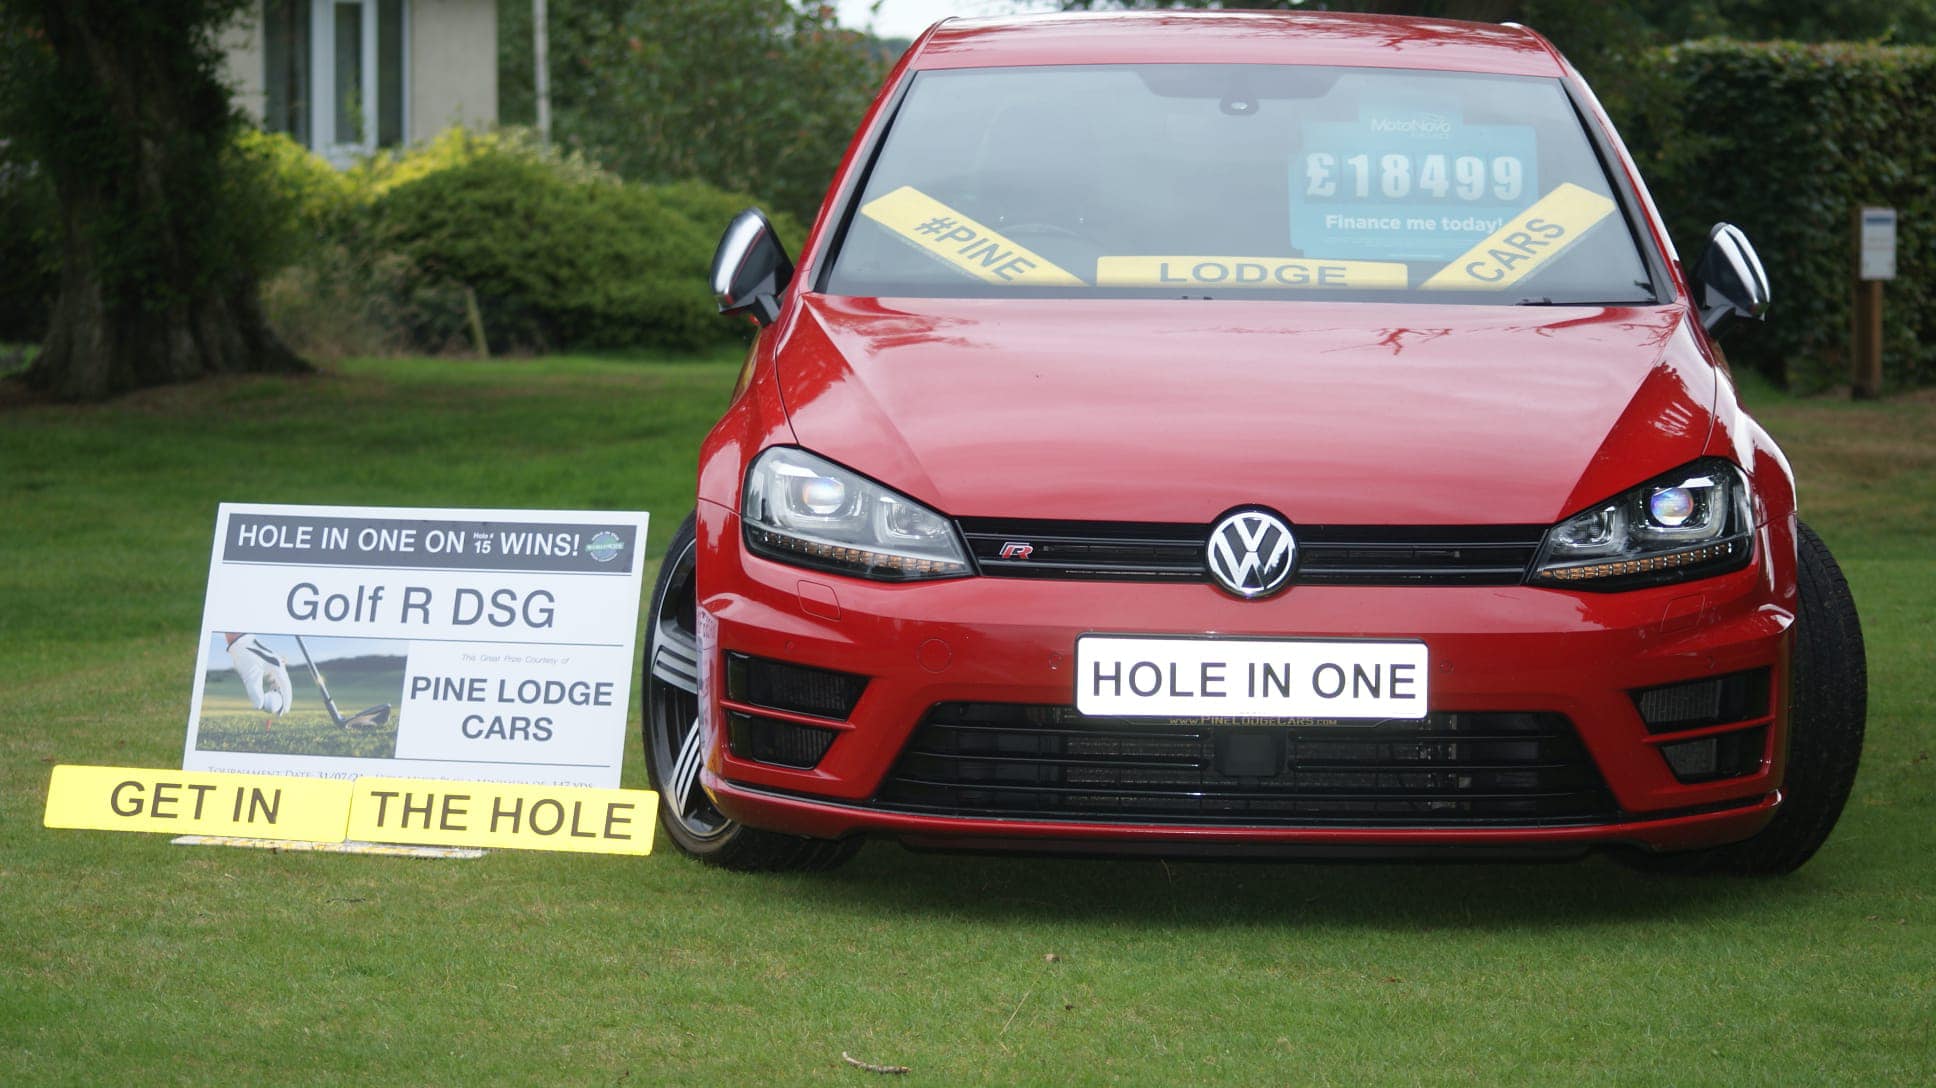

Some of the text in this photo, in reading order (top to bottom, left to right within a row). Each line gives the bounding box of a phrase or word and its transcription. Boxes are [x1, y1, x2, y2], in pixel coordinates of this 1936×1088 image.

[1306, 152, 1522, 201] £18499
[1325, 214, 1503, 235] Finance me today!
[913, 217, 1036, 282] #PINE
[1466, 217, 1566, 283] CARS
[1160, 262, 1348, 287] LODGE
[238, 524, 465, 553] HOLE IN ONE ON
[474, 540, 491, 553] 15
[500, 532, 580, 557] WINS!
[1000, 542, 1033, 559] R
[287, 582, 555, 628] Golf R DSG
[461, 654, 476, 662] This
[480, 654, 500, 663] Great
[504, 655, 521, 663] Prize
[525, 655, 557, 665] Courtesy
[411, 676, 614, 706] PINE LODGE
[1093, 661, 1416, 699] HOLE IN ONE
[461, 714, 553, 742] CARS
[110, 780, 281, 824] GET IN
[370, 791, 635, 840] THE HOLE
